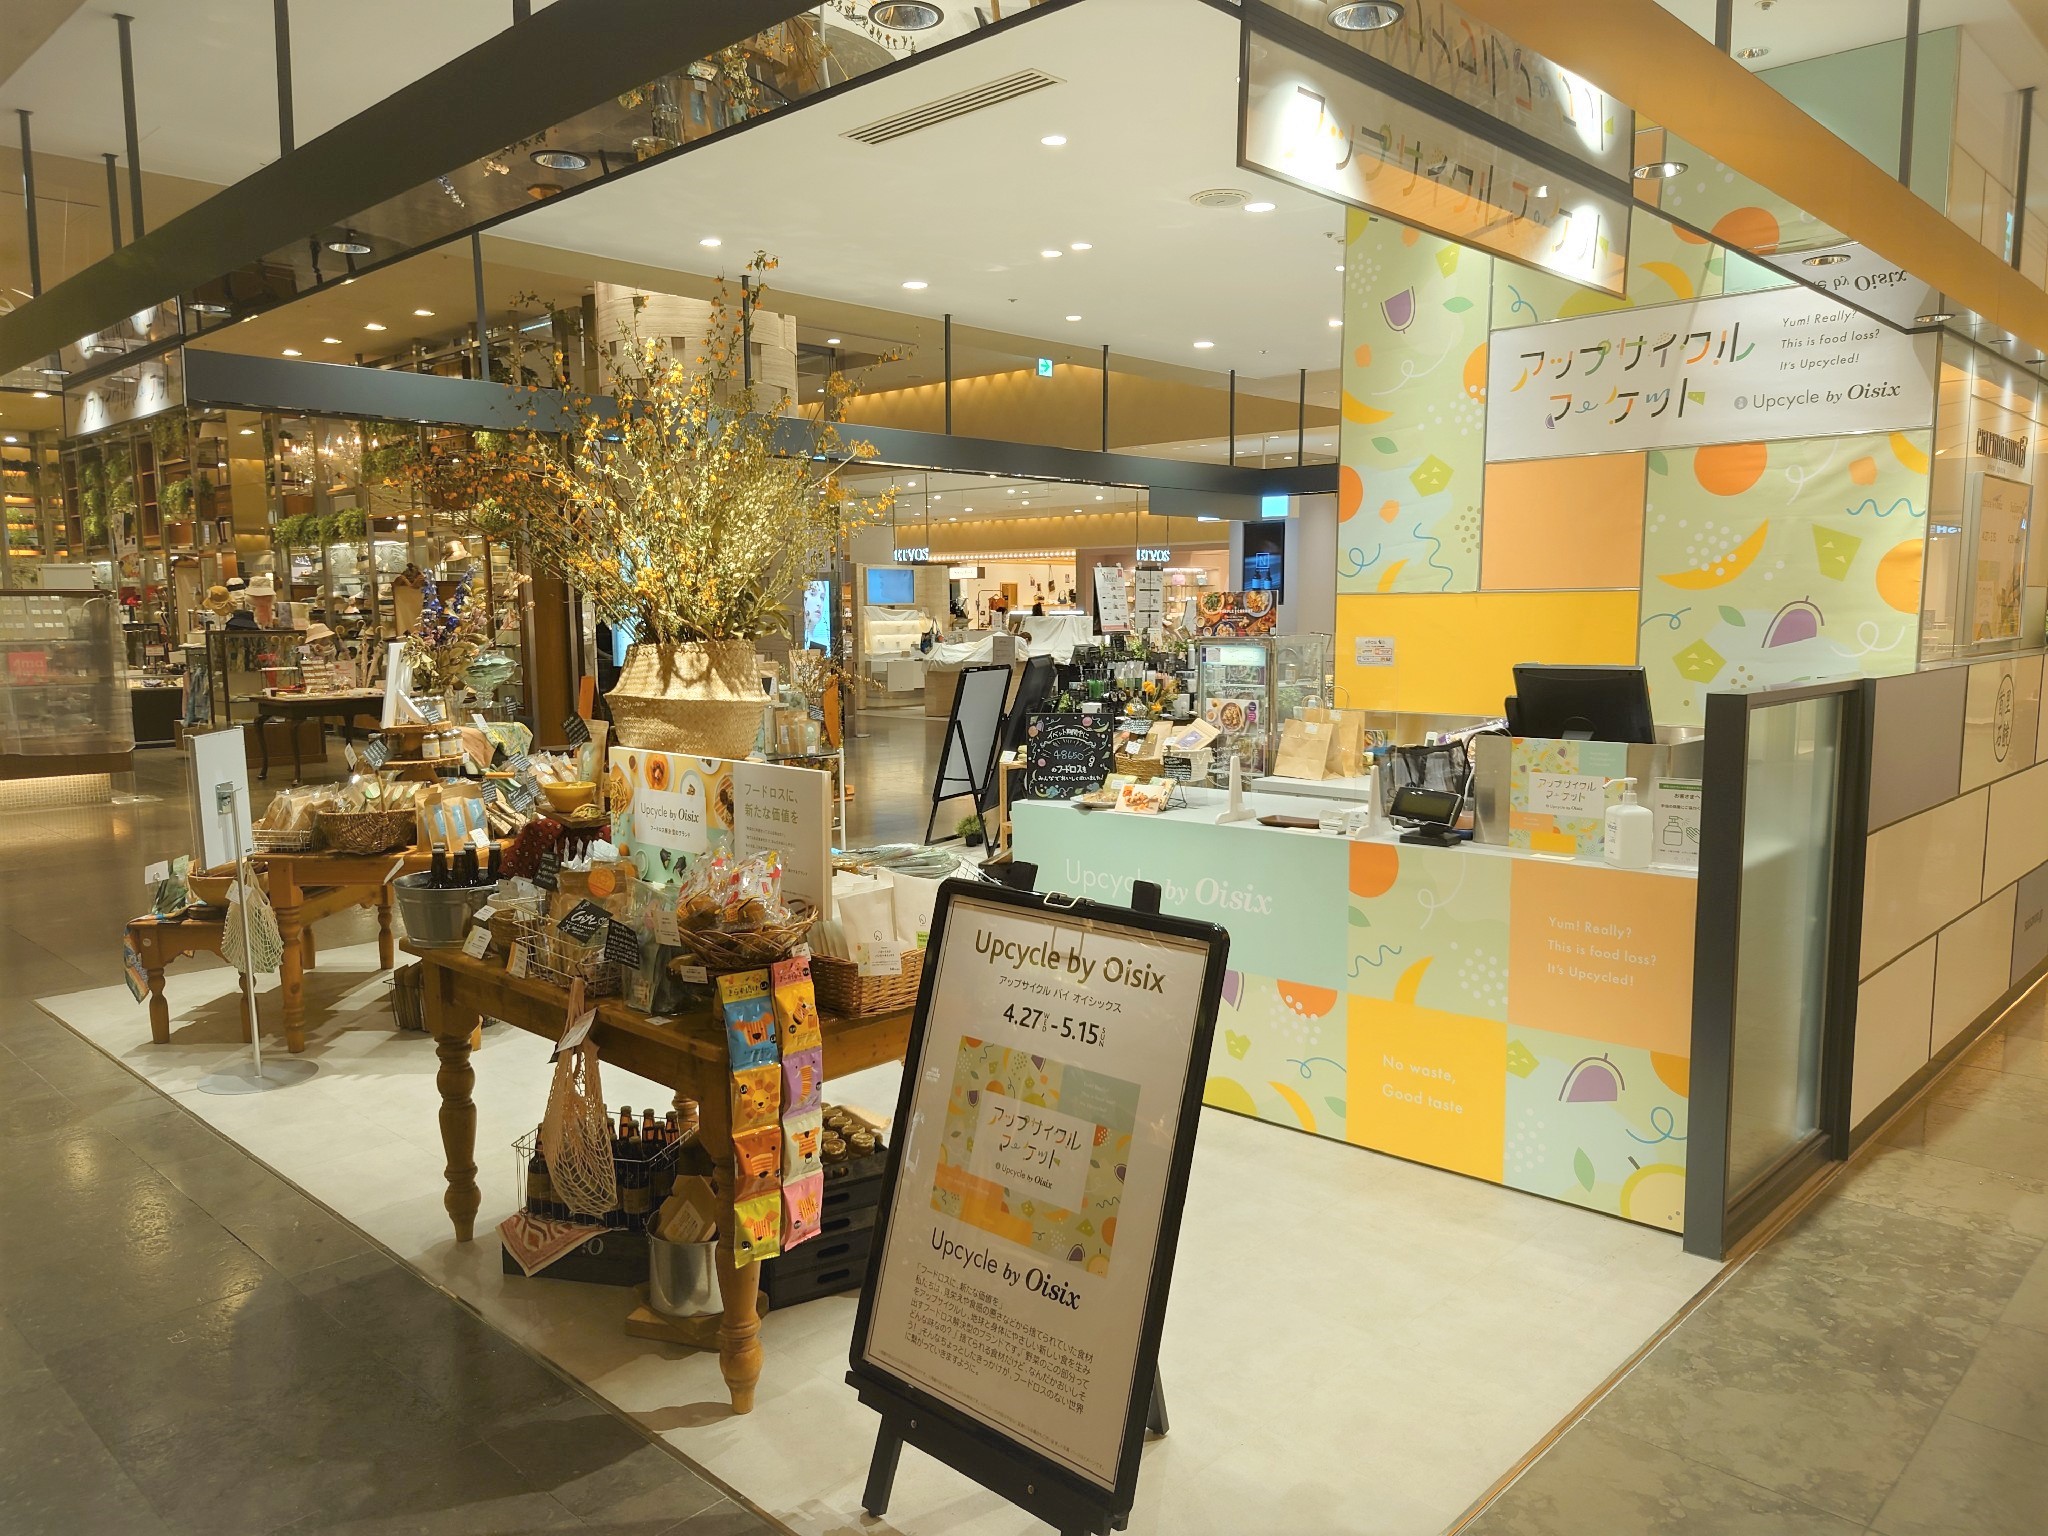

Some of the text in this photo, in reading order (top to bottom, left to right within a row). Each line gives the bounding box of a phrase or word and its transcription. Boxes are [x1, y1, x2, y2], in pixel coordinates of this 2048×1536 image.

[1782, 310, 1857, 328] Yum! Really?
[1781, 328, 1880, 349] This is food loss?
[1510, 321, 1756, 393] アップサイクル
[1779, 354, 1859, 371] It's Upcycled!
[1544, 377, 1706, 430] マーケット
[1752, 381, 1901, 411] Upcycle by Oisix
[640, 802, 699, 823] Upcycle by Oisix
[1165, 879, 1189, 906] by
[1195, 877, 1273, 915] Oisix
[1548, 916, 1632, 939] Yum! Really?
[975, 929, 1061, 970] Upcycle
[1066, 946, 1097, 984] by
[1103, 956, 1166, 994] Oisix
[1548, 939, 1657, 966] This is food loss?
[1569, 966, 1634, 986] Upcycled!
[999, 975, 1122, 1014] アップサイクル バイ オイシックス
[1003, 1003, 1044, 1030] 4.27
[1383, 1054, 1456, 1085] No waste,
[1382, 1083, 1463, 1114] Good taste
[987, 1106, 1082, 1151] アップサイクル
[1034, 1175, 1053, 1190] Oisix
[931, 1226, 1082, 1310] Upcycle by Oisix
